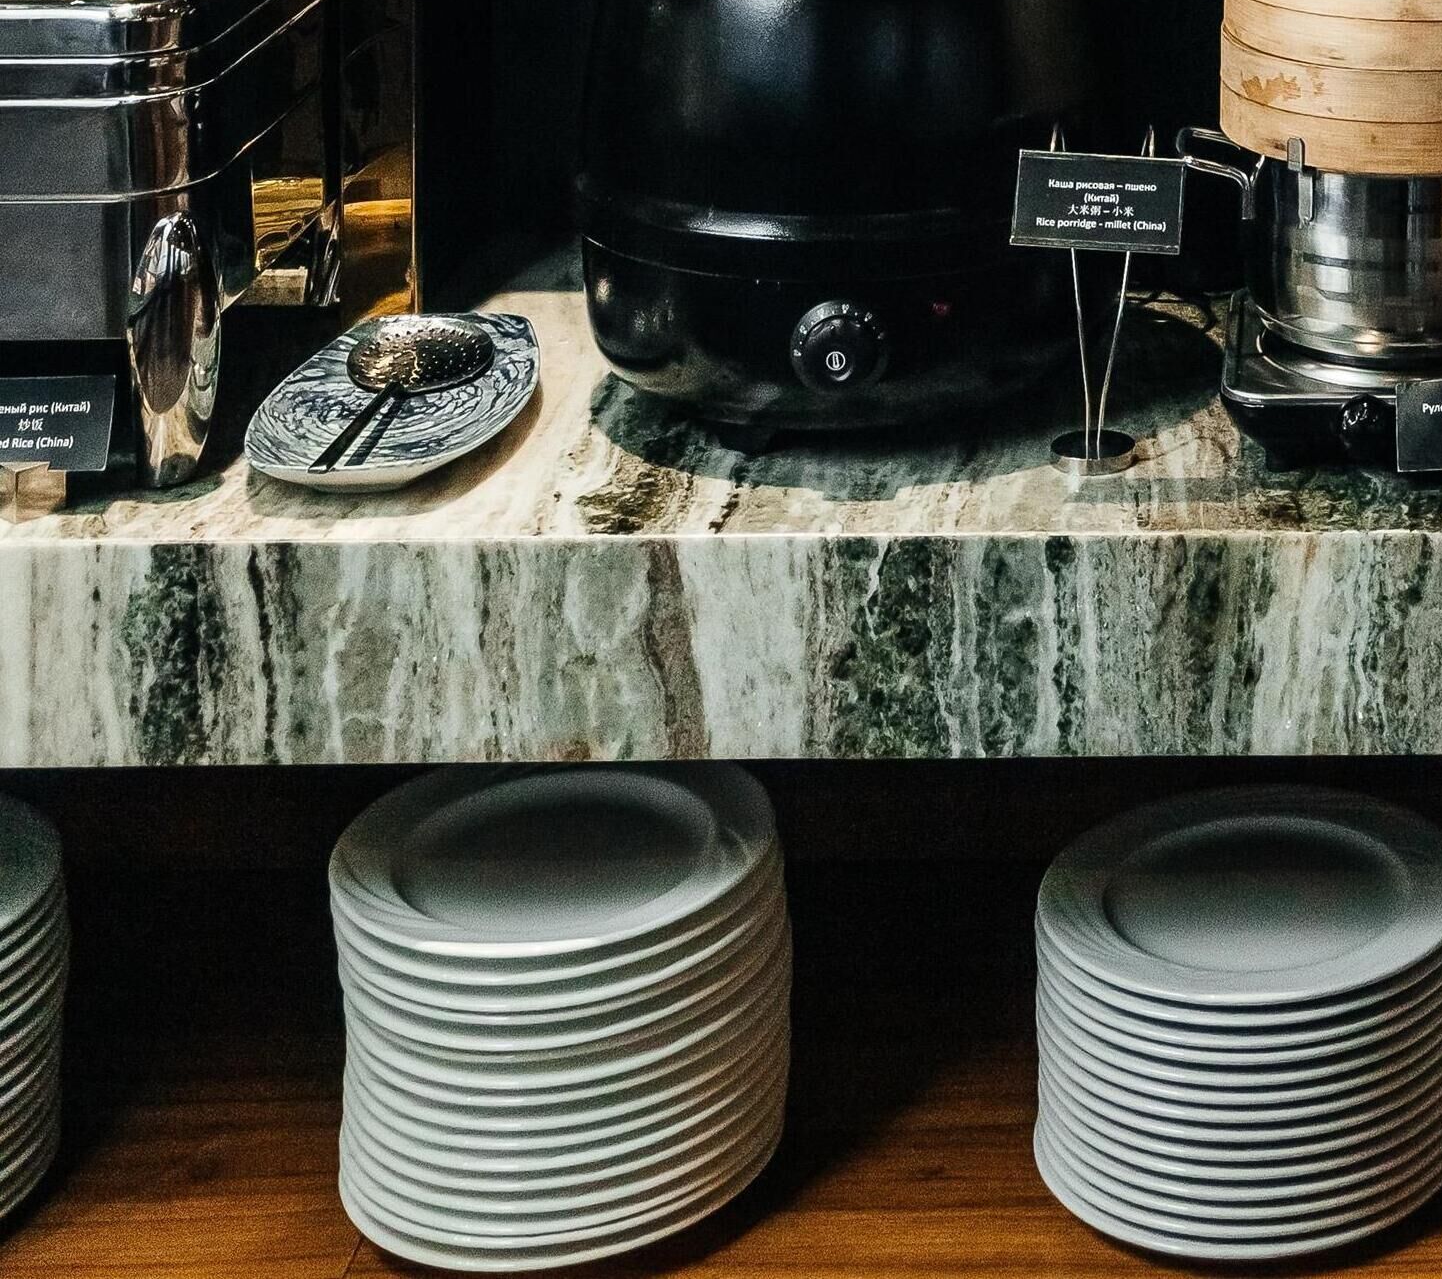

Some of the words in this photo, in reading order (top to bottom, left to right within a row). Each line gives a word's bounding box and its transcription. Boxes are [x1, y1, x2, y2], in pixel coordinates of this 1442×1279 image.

[1048, 178, 1074, 189] Каша
[1075, 181, 1115, 191] рисовая
[1124, 183, 1157, 192] пшено
[1083, 193, 1120, 205] (Китай)
[1035, 216, 1056, 227] Rice
[1057, 218, 1097, 230] porridge
[1104, 220, 1131, 230] millet
[1133, 221, 1167, 232] (China)
[28, 404, 49, 416] рис
[51, 401, 91, 416] (Китай)
[11, 436, 34, 448] Rice
[36, 435, 74, 450] (China)
